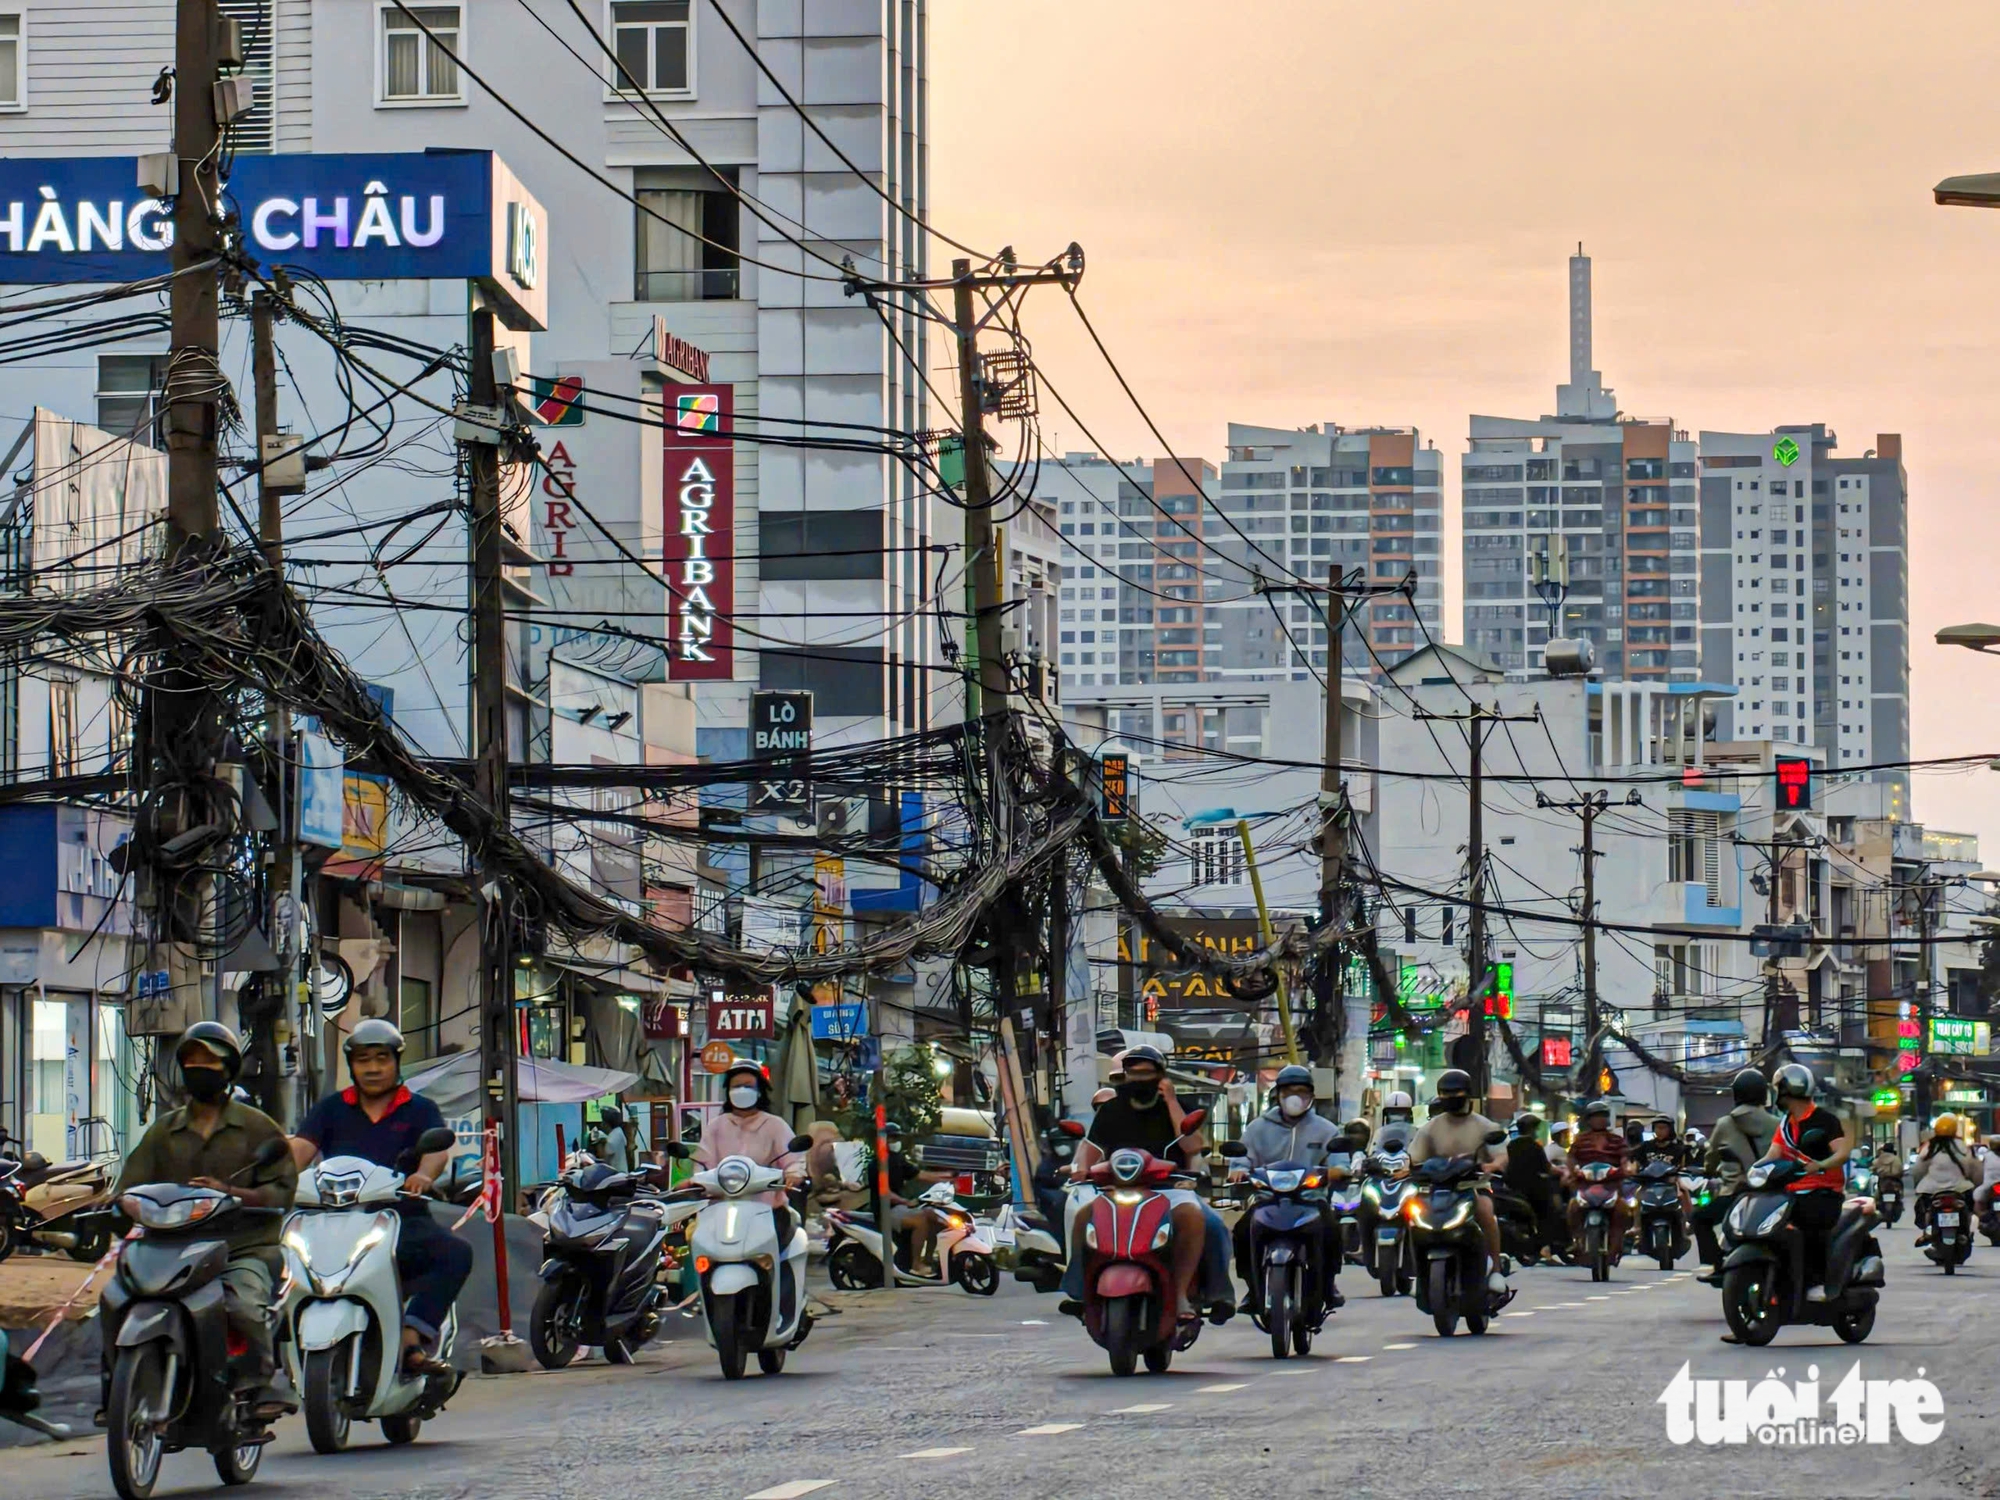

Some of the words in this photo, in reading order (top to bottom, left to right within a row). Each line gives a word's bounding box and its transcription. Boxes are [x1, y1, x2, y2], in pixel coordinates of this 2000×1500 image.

[252, 181, 445, 250] CHÂU
[679, 456, 716, 661] AGRIBANK
[769, 701, 796, 722] LÒ
[755, 727, 808, 749] BÁNH
[717, 1009, 766, 1030] ATM
